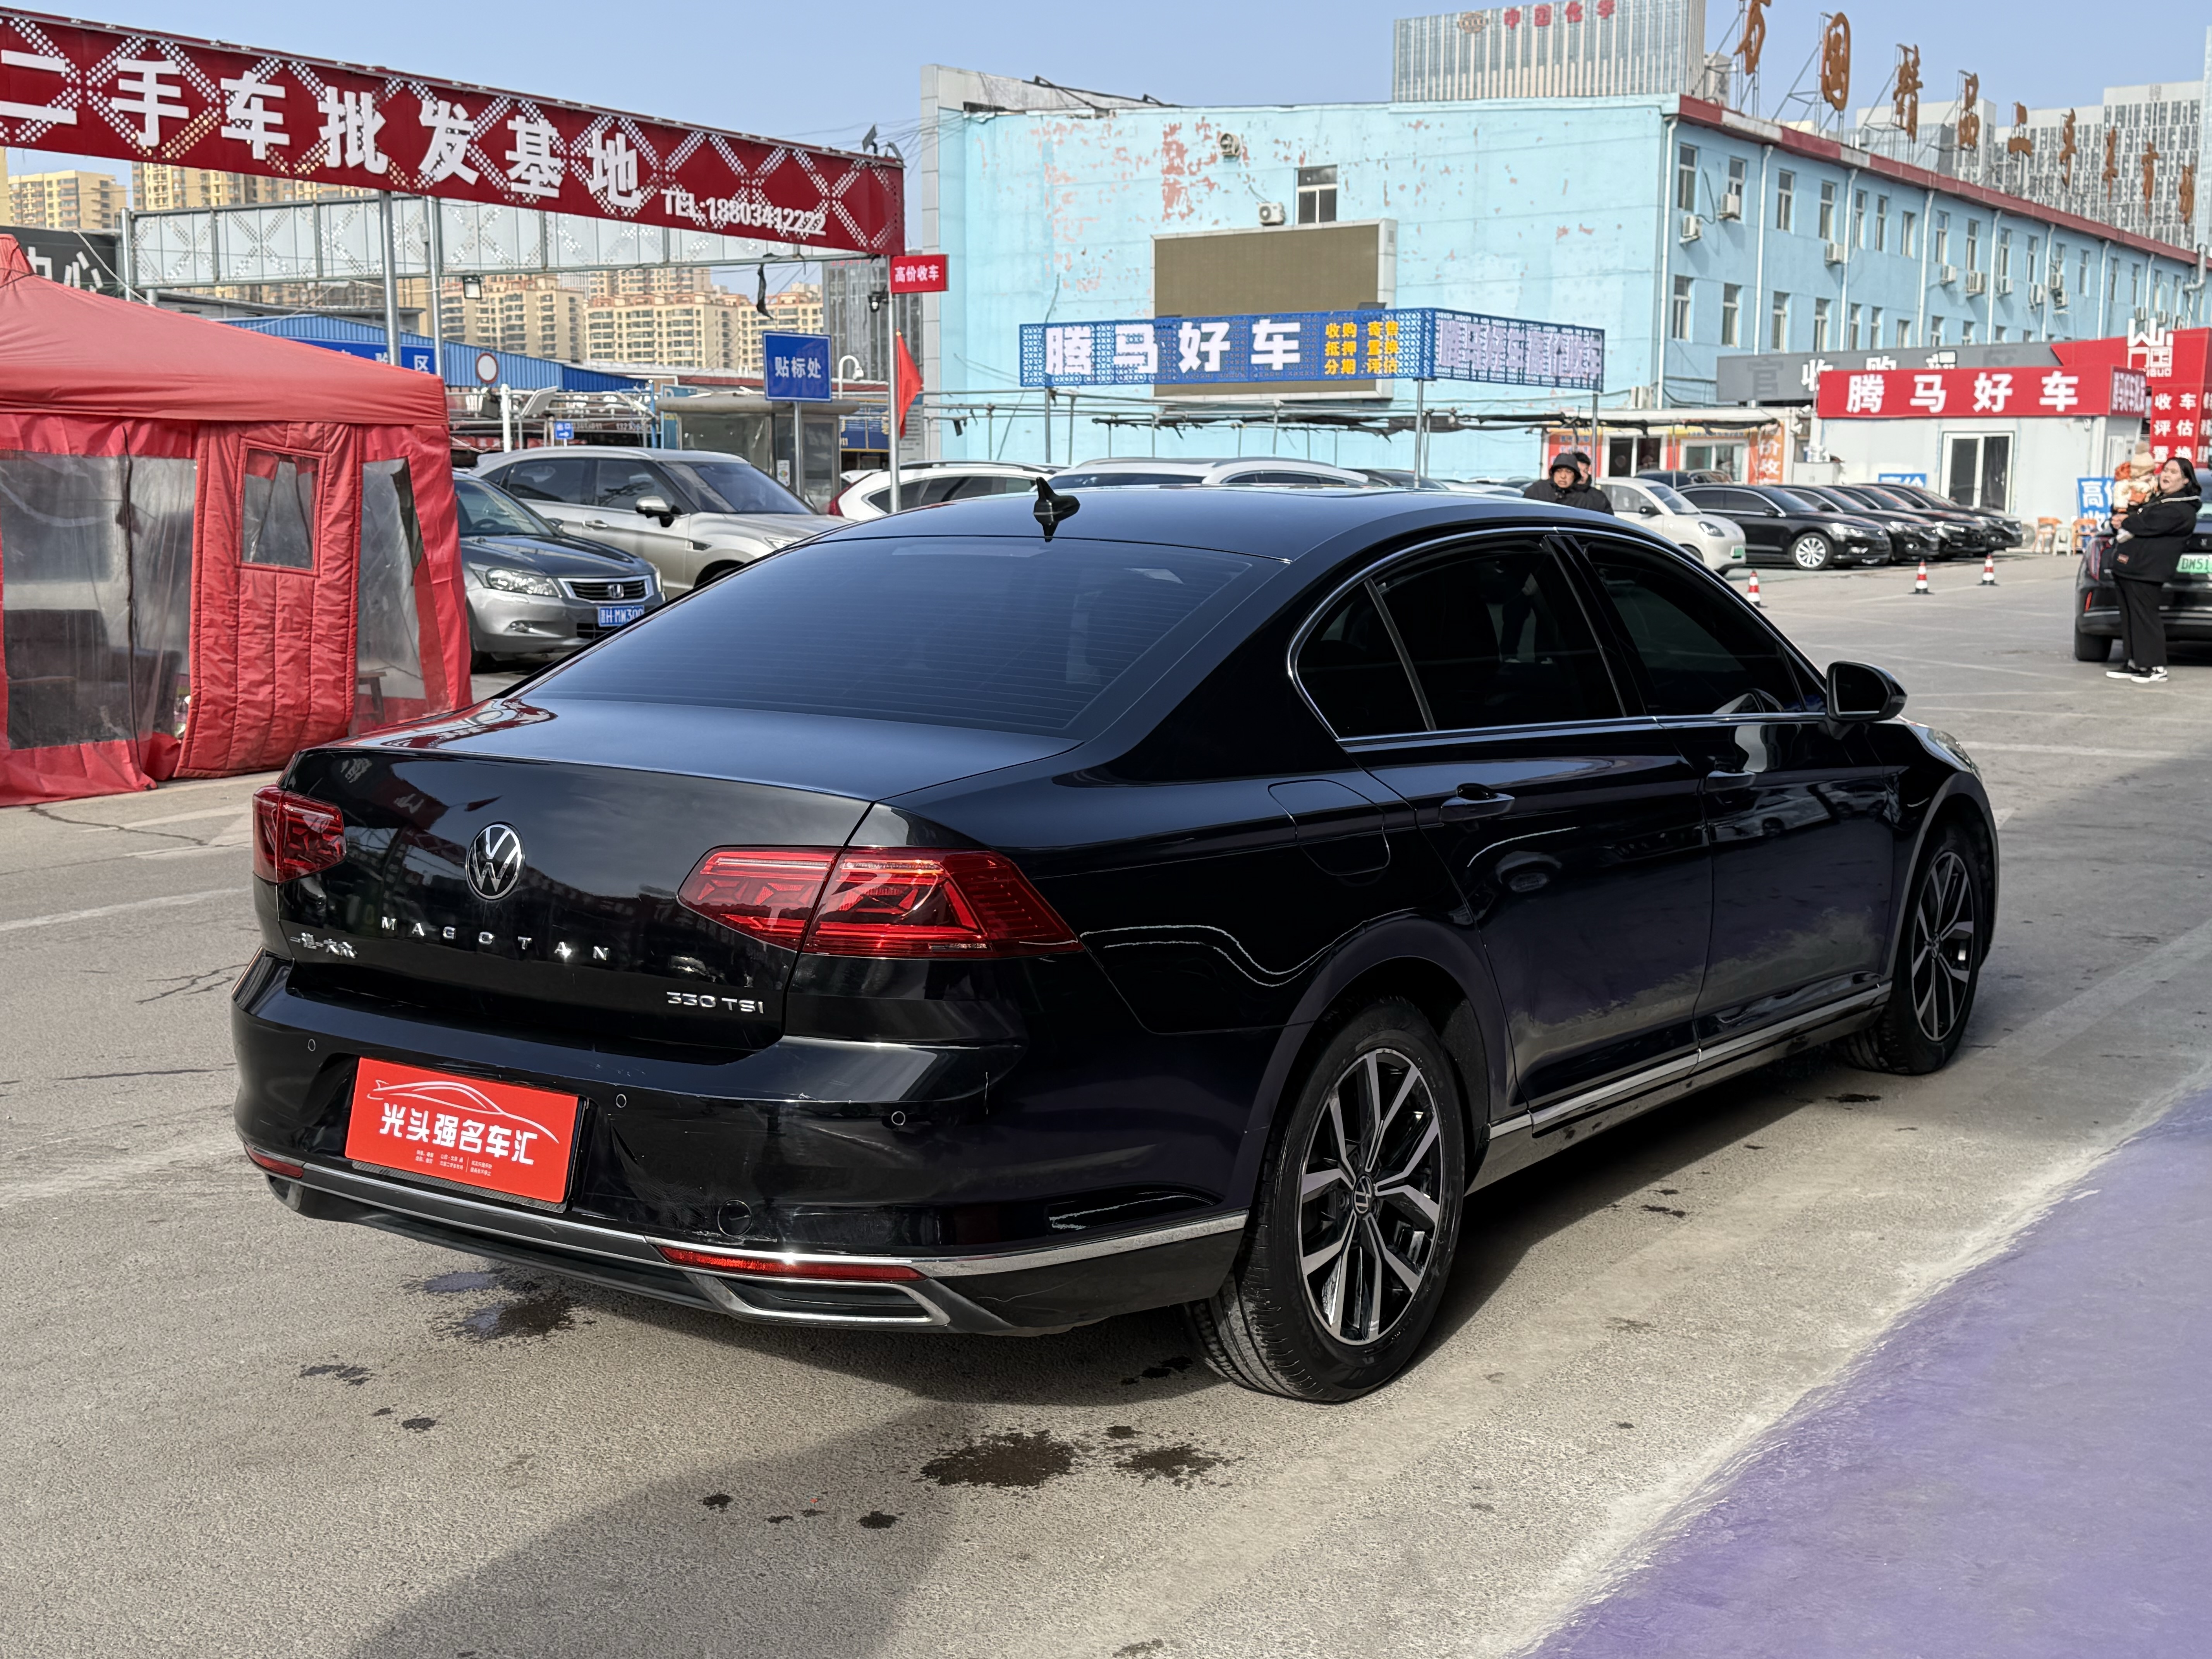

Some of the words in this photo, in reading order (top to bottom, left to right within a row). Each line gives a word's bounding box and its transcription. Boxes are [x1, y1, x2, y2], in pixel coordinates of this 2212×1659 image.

[1504, 0, 1615, 30] 中国化学
[0, 49, 642, 208] 二手车批发基地
[895, 264, 939, 283] 高价收车
[1326, 323, 1357, 338] 收购
[1044, 318, 1302, 376] 腾马好车
[1325, 341, 1357, 356] 抵押
[775, 356, 821, 379] 贴标处
[1324, 359, 1356, 375] 分期
[1367, 358, 1398, 373] 评估
[1846, 371, 2080, 414] 腾马好车
[2154, 393, 2197, 410] 收车
[2153, 419, 2195, 437] 评估
[381, 916, 609, 961] MAGOTAN
[666, 991, 716, 1008] 330
[721, 998, 764, 1014] TSI
[379, 1102, 538, 1165] 光头强名车汇
